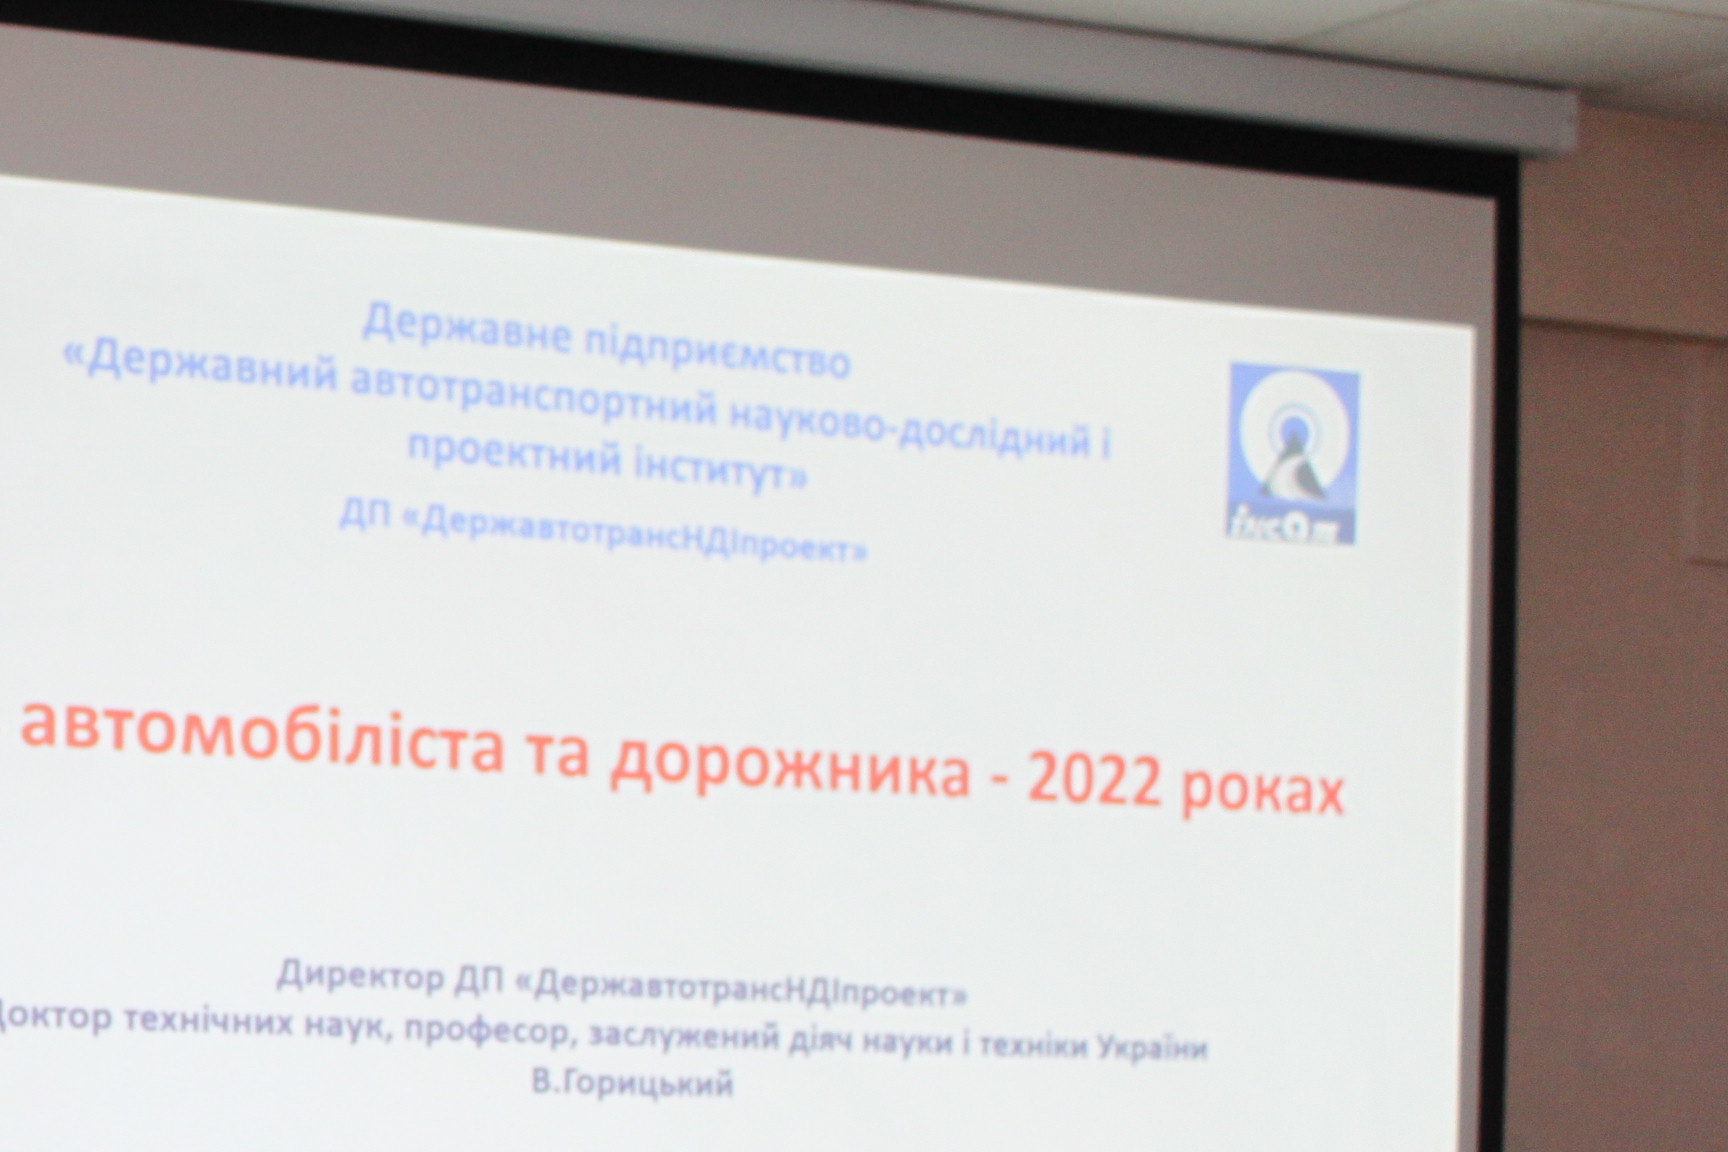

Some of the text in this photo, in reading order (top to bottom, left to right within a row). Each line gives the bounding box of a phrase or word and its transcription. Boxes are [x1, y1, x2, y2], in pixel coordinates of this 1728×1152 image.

[363, 301, 852, 379] Державне підприємство
[63, 336, 1112, 460] «Державний автотранспортний науково-дослідний і
[408, 432, 809, 496] проектний інститут»
[339, 497, 869, 563] ДП «ДержавтотрансНДІпроект»
[21, 702, 504, 773] автомобіліста
[524, 734, 589, 778] та
[609, 738, 971, 800] дорожника
[989, 774, 1010, 785] -
[1027, 749, 1163, 808] 2022
[1181, 768, 1346, 822] роках
[275, 957, 969, 1011] Директор ДП «ДержавтотрансНДІпроект»
[123, 1004, 293, 1036] технічних
[305, 1016, 394, 1045] наук,
[404, 1013, 579, 1050] професор,
[589, 1020, 780, 1055] заслужений
[788, 1026, 853, 1057] діяч
[862, 1032, 955, 1060] науки
[962, 1028, 971, 1056] і
[979, 1030, 1089, 1059] техніки
[1096, 1032, 1210, 1067] України
[531, 1066, 734, 1102] В.Горицький
